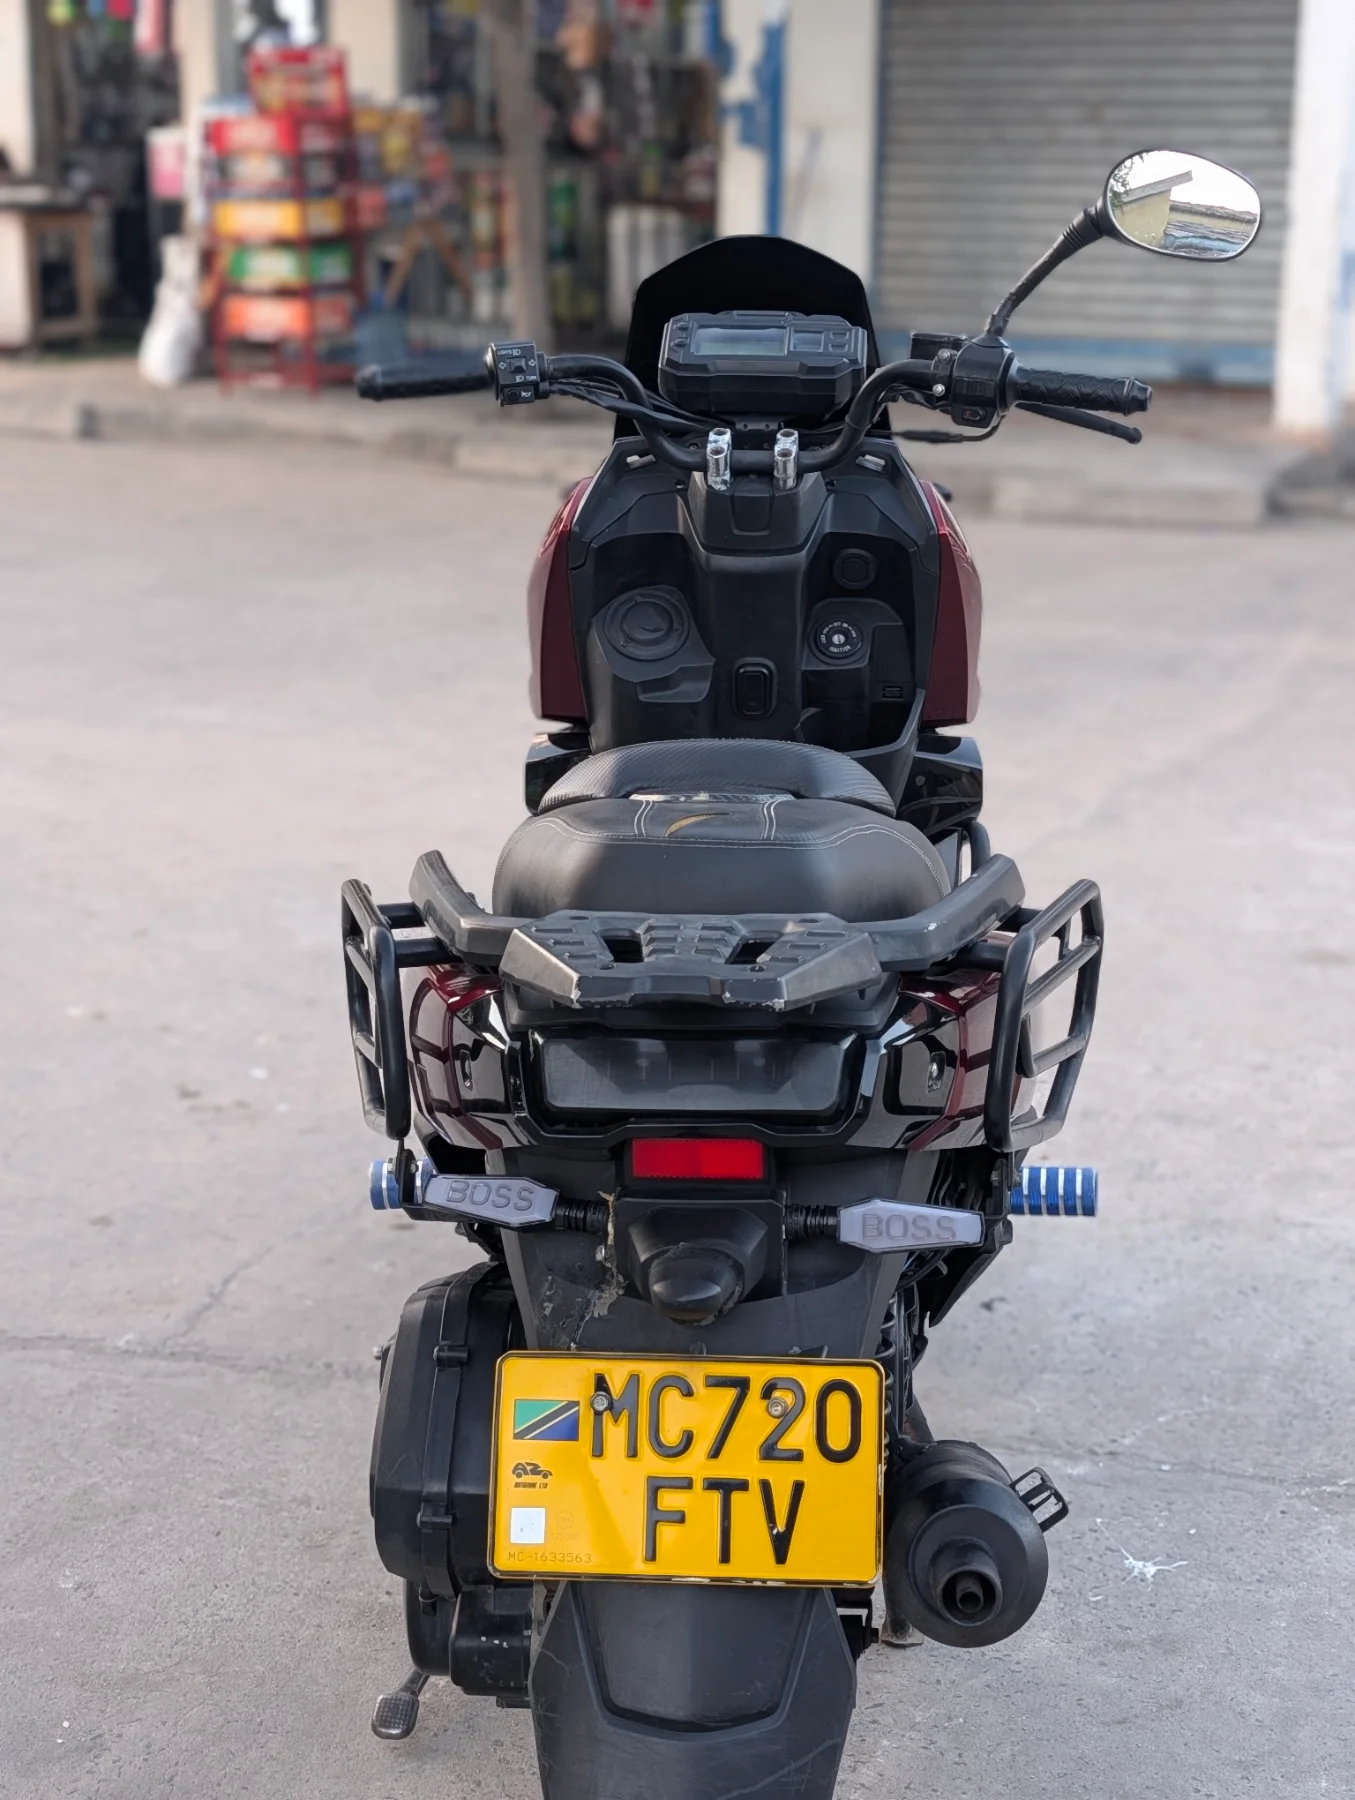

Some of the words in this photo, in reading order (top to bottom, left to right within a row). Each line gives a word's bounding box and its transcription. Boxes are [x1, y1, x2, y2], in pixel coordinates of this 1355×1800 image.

[445, 1180, 534, 1211] BOSS
[861, 1213, 957, 1241] BOSS
[591, 1372, 862, 1464] MC720
[643, 1476, 806, 1566] FTV
